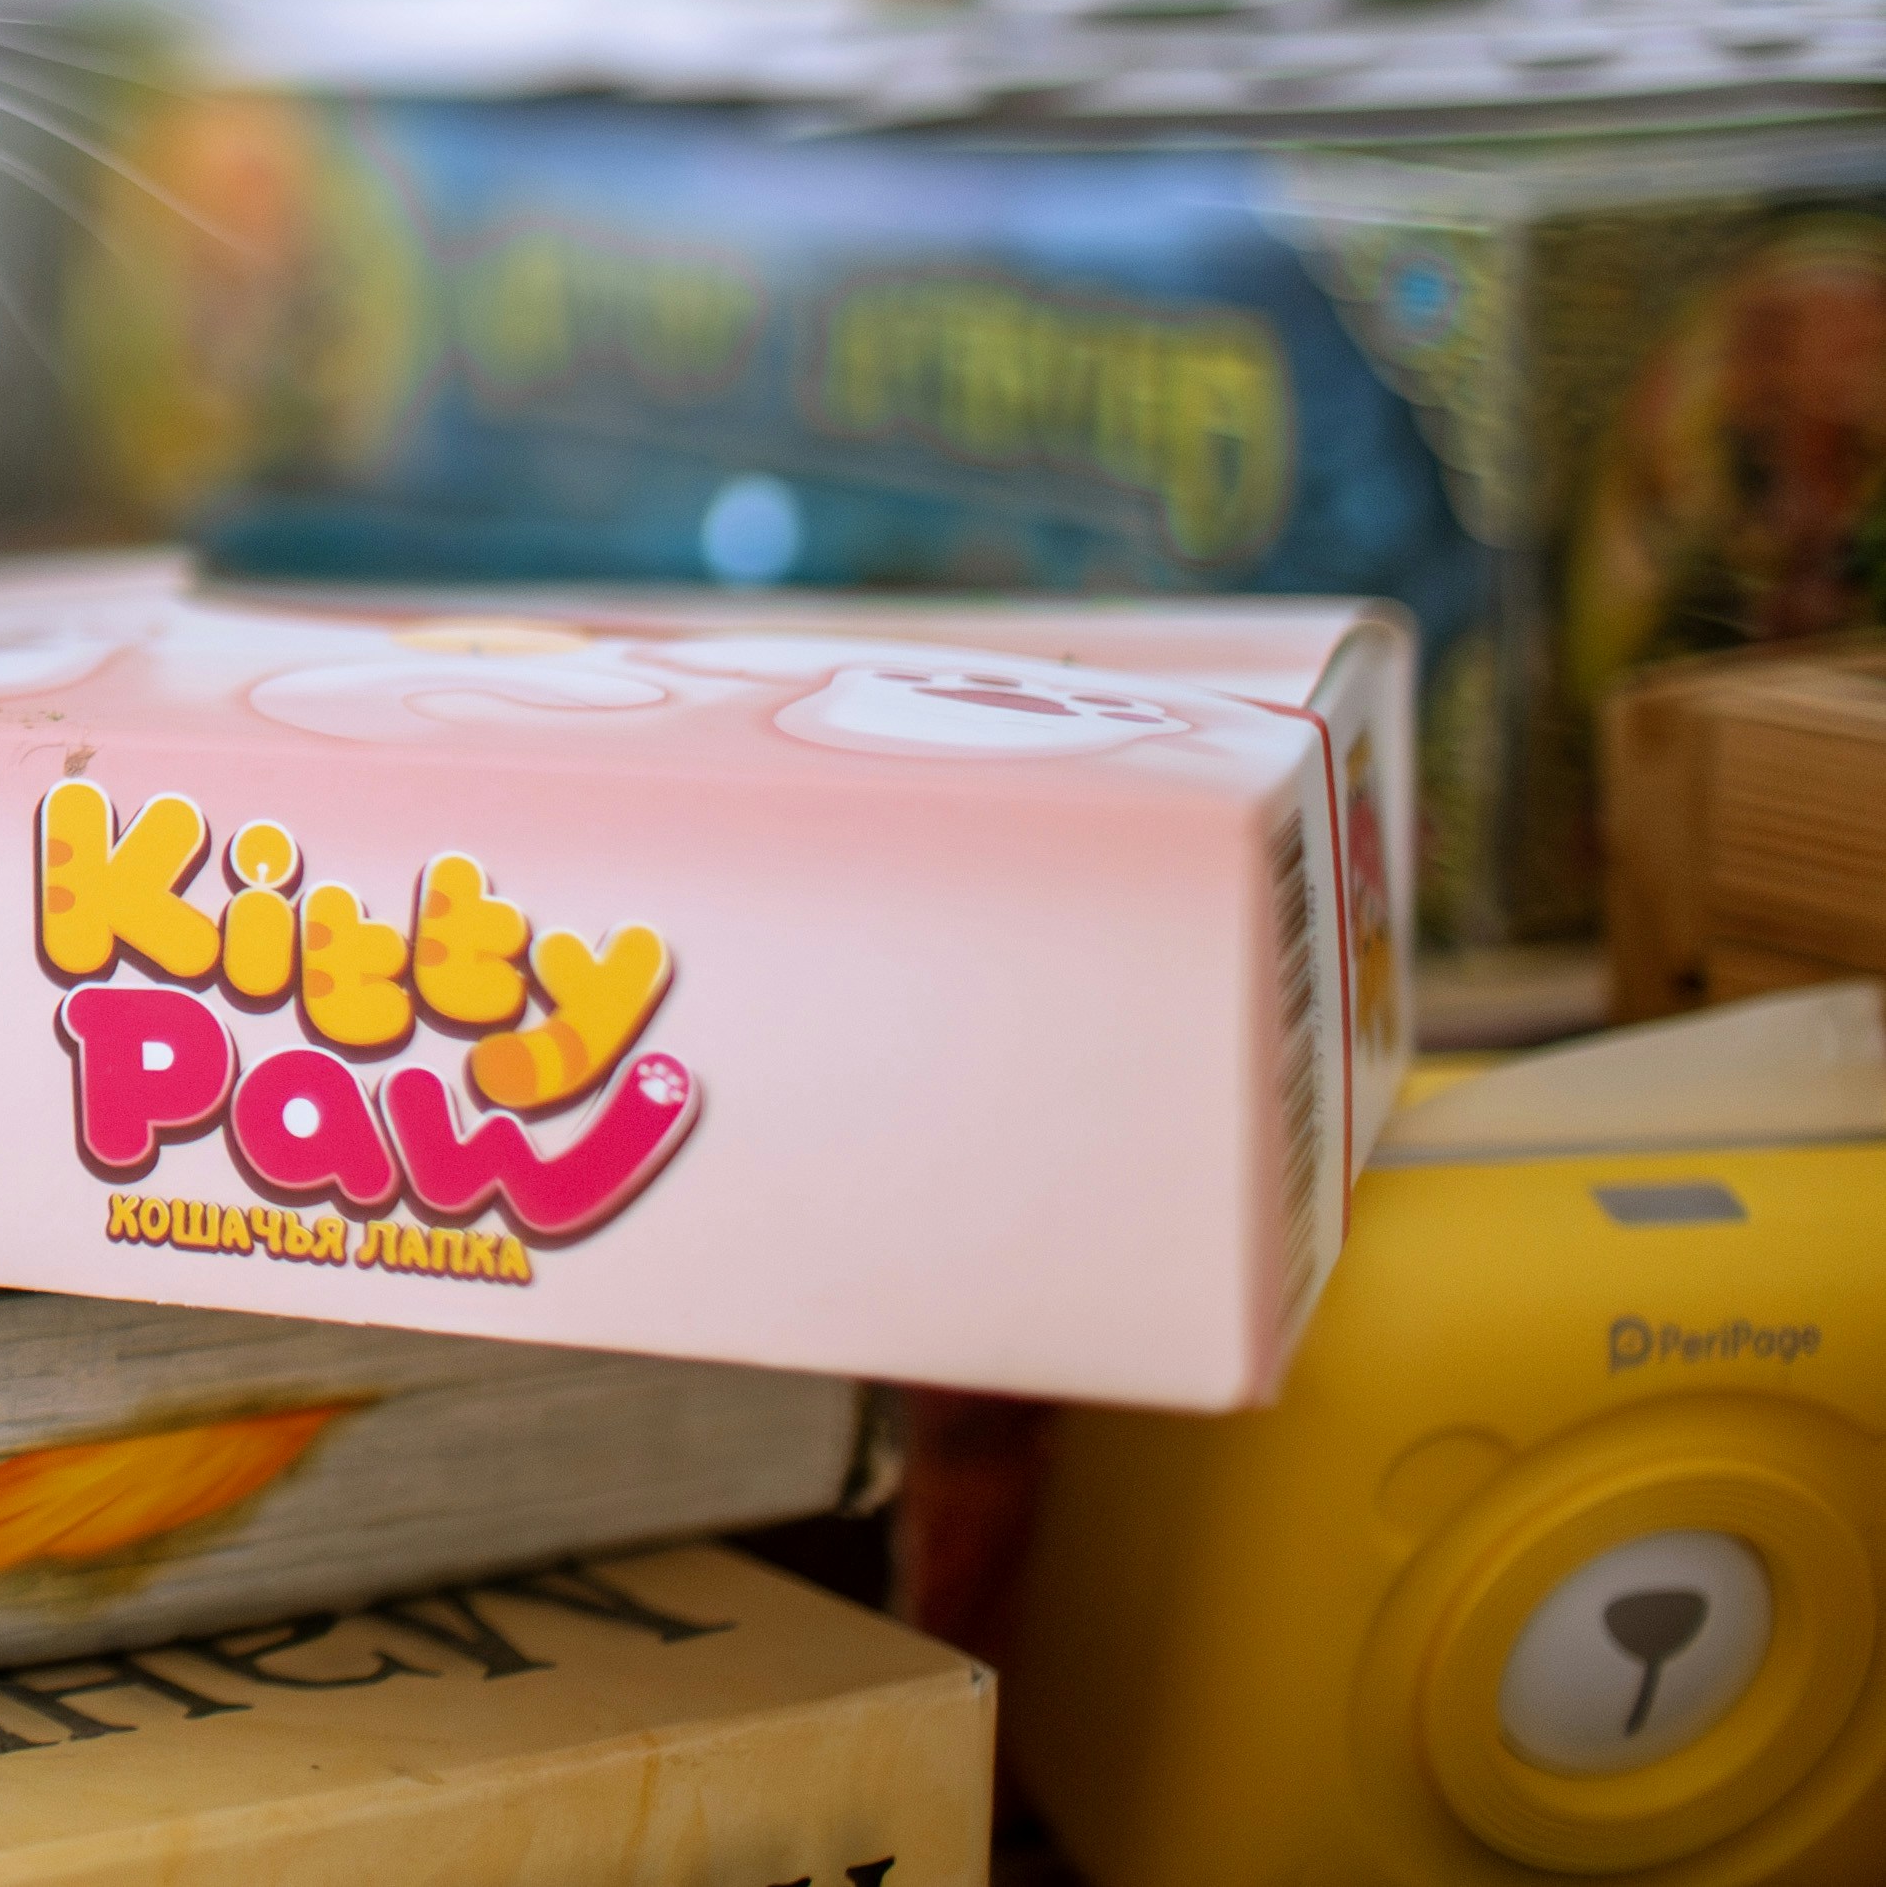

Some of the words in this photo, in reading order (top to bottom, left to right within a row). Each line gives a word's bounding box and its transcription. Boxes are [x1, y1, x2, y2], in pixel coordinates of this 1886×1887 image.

[35, 778, 673, 1111] Kitty
[54, 982, 702, 1250] Paw
[106, 1192, 347, 1266] КОШАЧЬЯ
[355, 1219, 533, 1287] ЛАПКА
[1658, 1317, 1822, 1365] PeriPage
